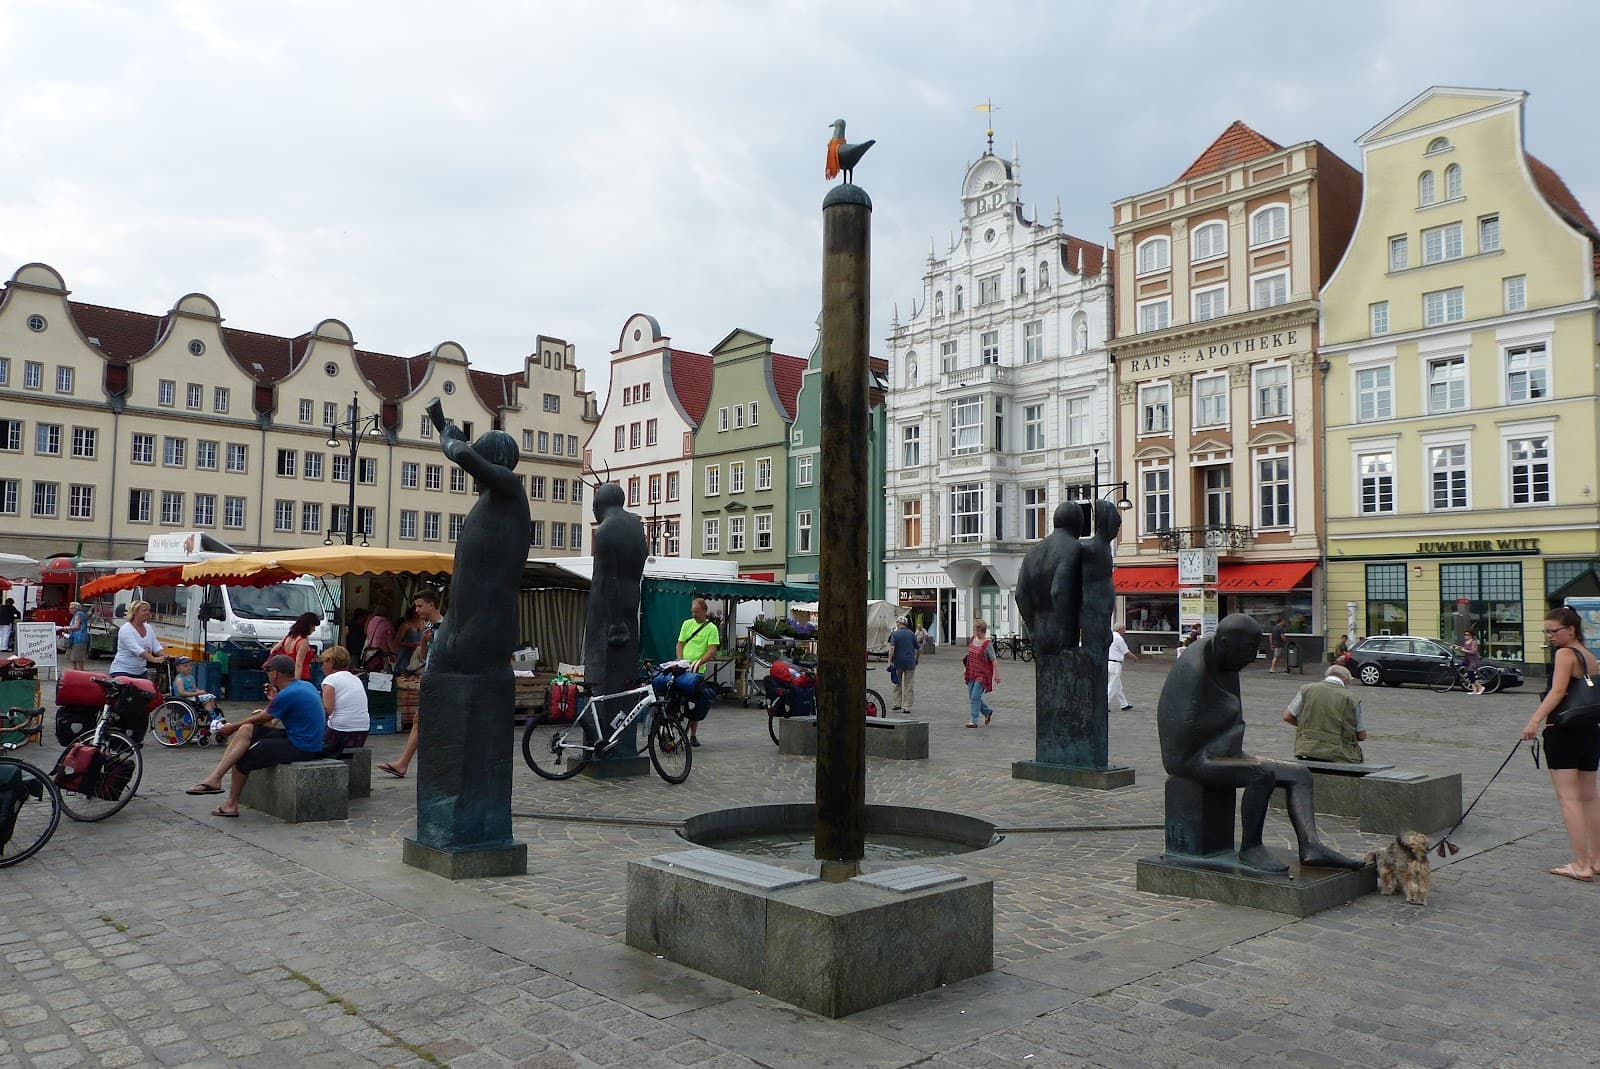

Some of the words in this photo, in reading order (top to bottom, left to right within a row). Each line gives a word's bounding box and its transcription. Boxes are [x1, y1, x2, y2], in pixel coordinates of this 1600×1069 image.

[1131, 355, 1170, 372] RATS
[1195, 330, 1297, 361] APOTHEKE
[1416, 540, 1492, 552] JUWELIER
[1496, 538, 1539, 549] WITT
[900, 592, 908, 600] 20
